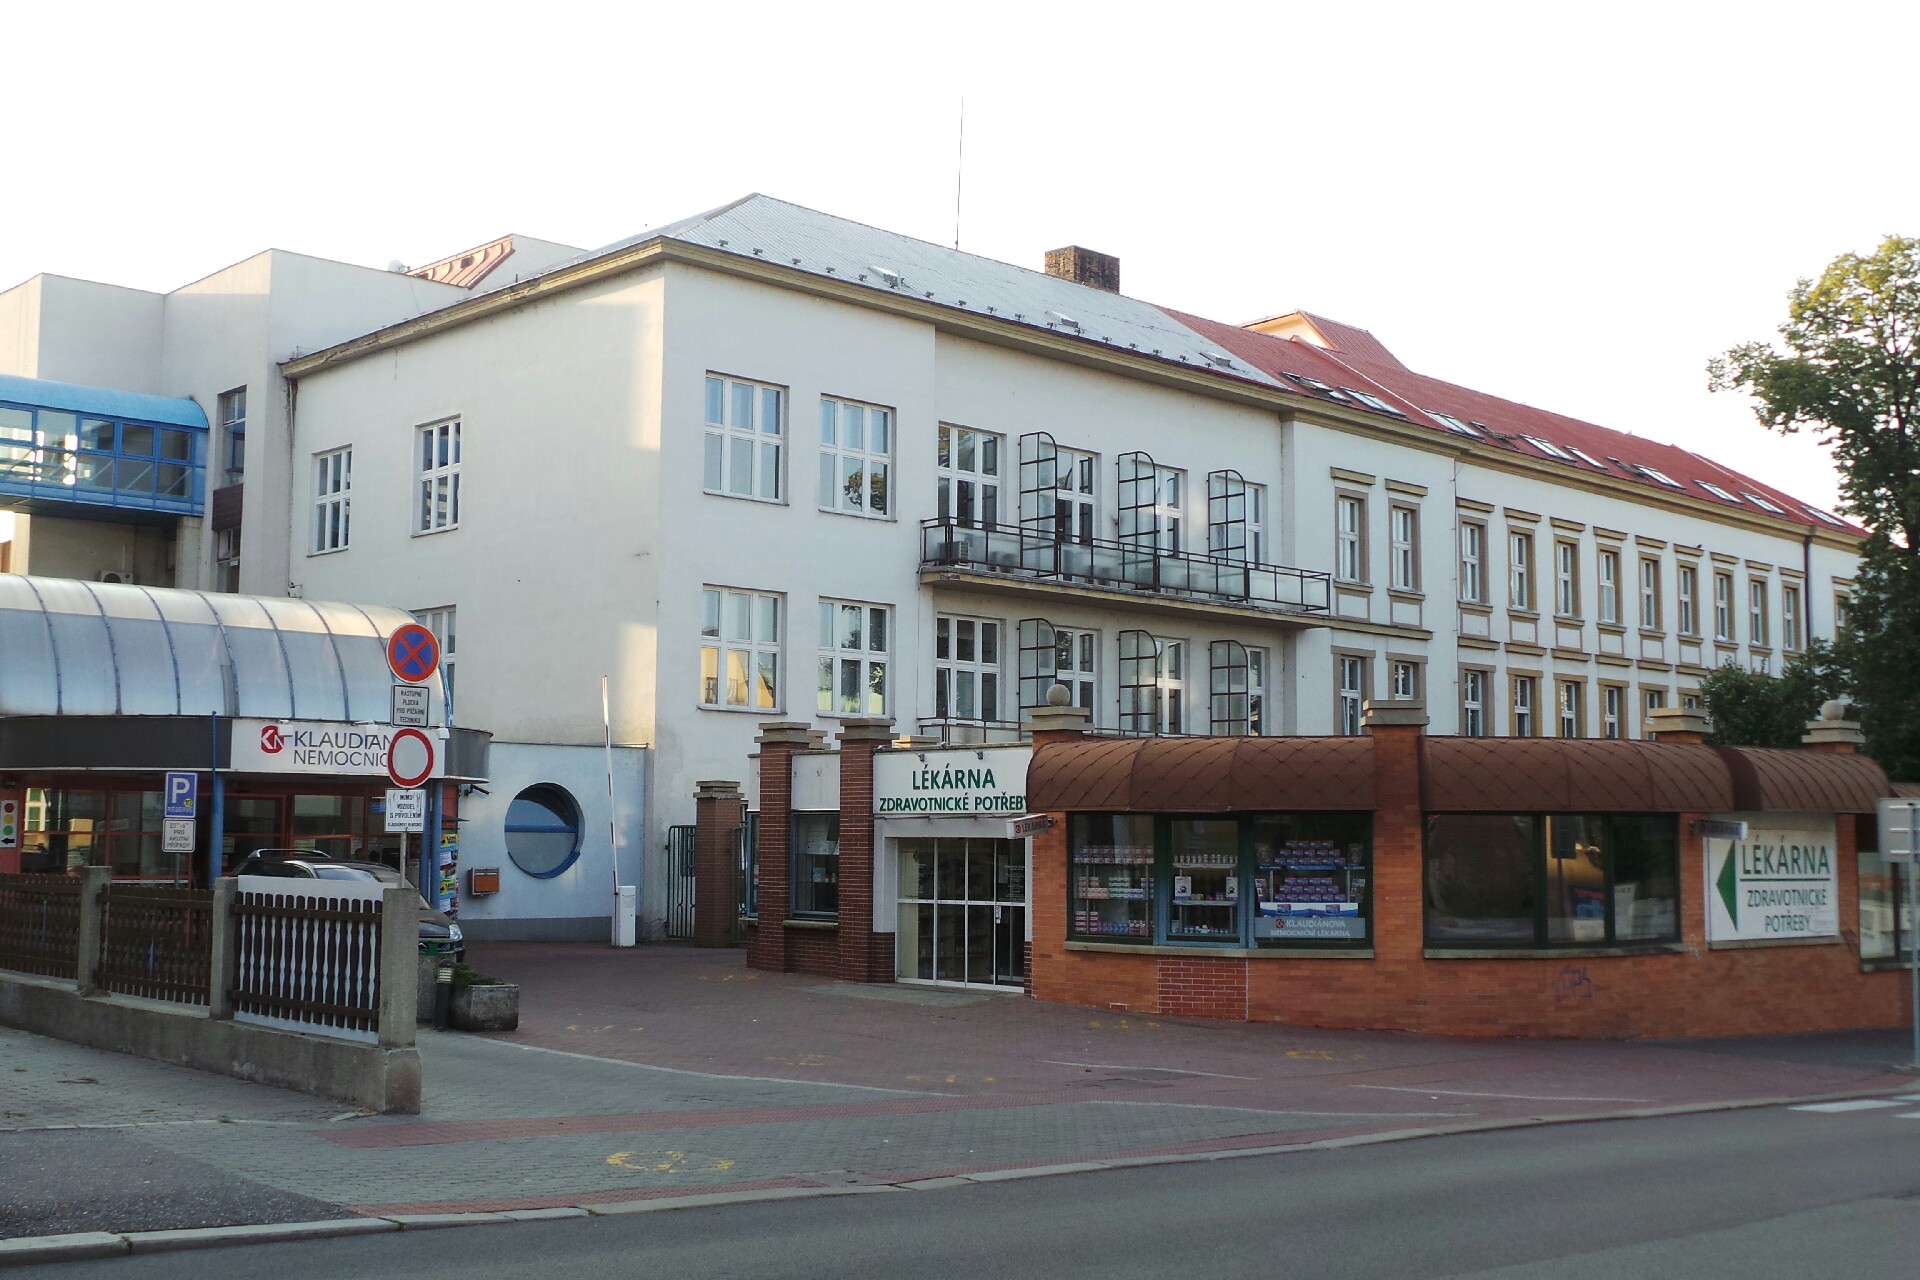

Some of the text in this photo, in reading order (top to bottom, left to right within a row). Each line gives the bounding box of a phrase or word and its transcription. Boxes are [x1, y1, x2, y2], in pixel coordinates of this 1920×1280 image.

[912, 763, 996, 791] LÉKÁRNA
[172, 777, 190, 804] P
[879, 792, 970, 812] ZDRAVOTNICKÉ
[1742, 834, 1830, 875] LÉKÁRNA
[1747, 883, 1828, 908] ZDRAVOTNICKÉ
[1286, 918, 1346, 929] KLAUDIÁNOVA
[1765, 909, 1812, 932] POTŘEBY
